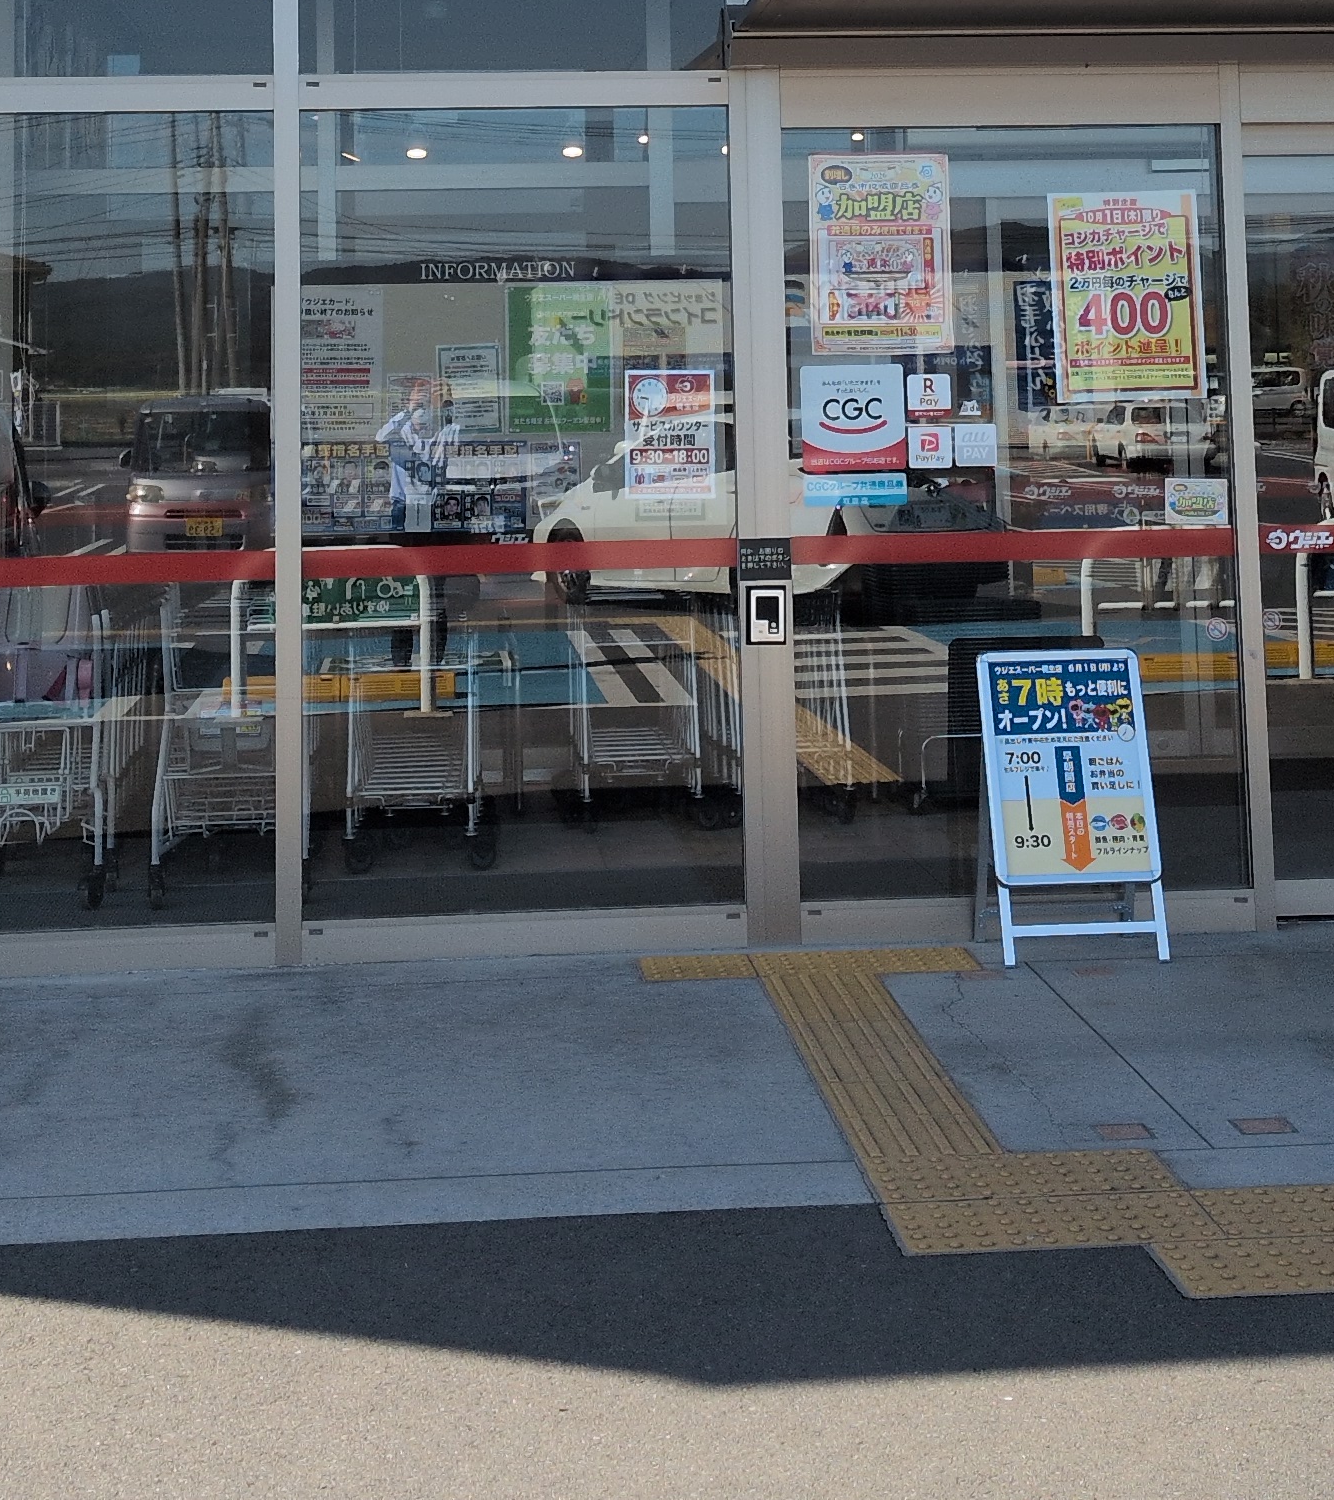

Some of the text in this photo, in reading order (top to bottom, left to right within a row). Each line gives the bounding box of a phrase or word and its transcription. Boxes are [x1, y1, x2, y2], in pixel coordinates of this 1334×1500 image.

[835, 191, 923, 221] 加盟店
[1064, 221, 1167, 247] コジカチャージで
[1066, 240, 1185, 274] 特別ポイント
[420, 261, 576, 280] INFORMATION
[1069, 274, 1188, 290] 2万円毎のチャージで
[1168, 287, 1188, 299] なんと
[1078, 291, 1169, 336] 400
[528, 325, 596, 345] 友だち
[923, 378, 935, 394] R
[823, 398, 883, 421] CGC
[920, 397, 939, 408] Pay
[643, 433, 696, 447] 受付時間
[962, 431, 989, 443] au
[915, 454, 945, 463] PayPay
[963, 446, 989, 460] PAY
[996, 677, 1128, 706] あさ 7時 もっと便利に
[1005, 751, 1041, 765] 7:00
[1089, 770, 1124, 779] お弁当の
[1014, 834, 1051, 849] 9:30
[1096, 846, 1149, 856] フルラインナップ
